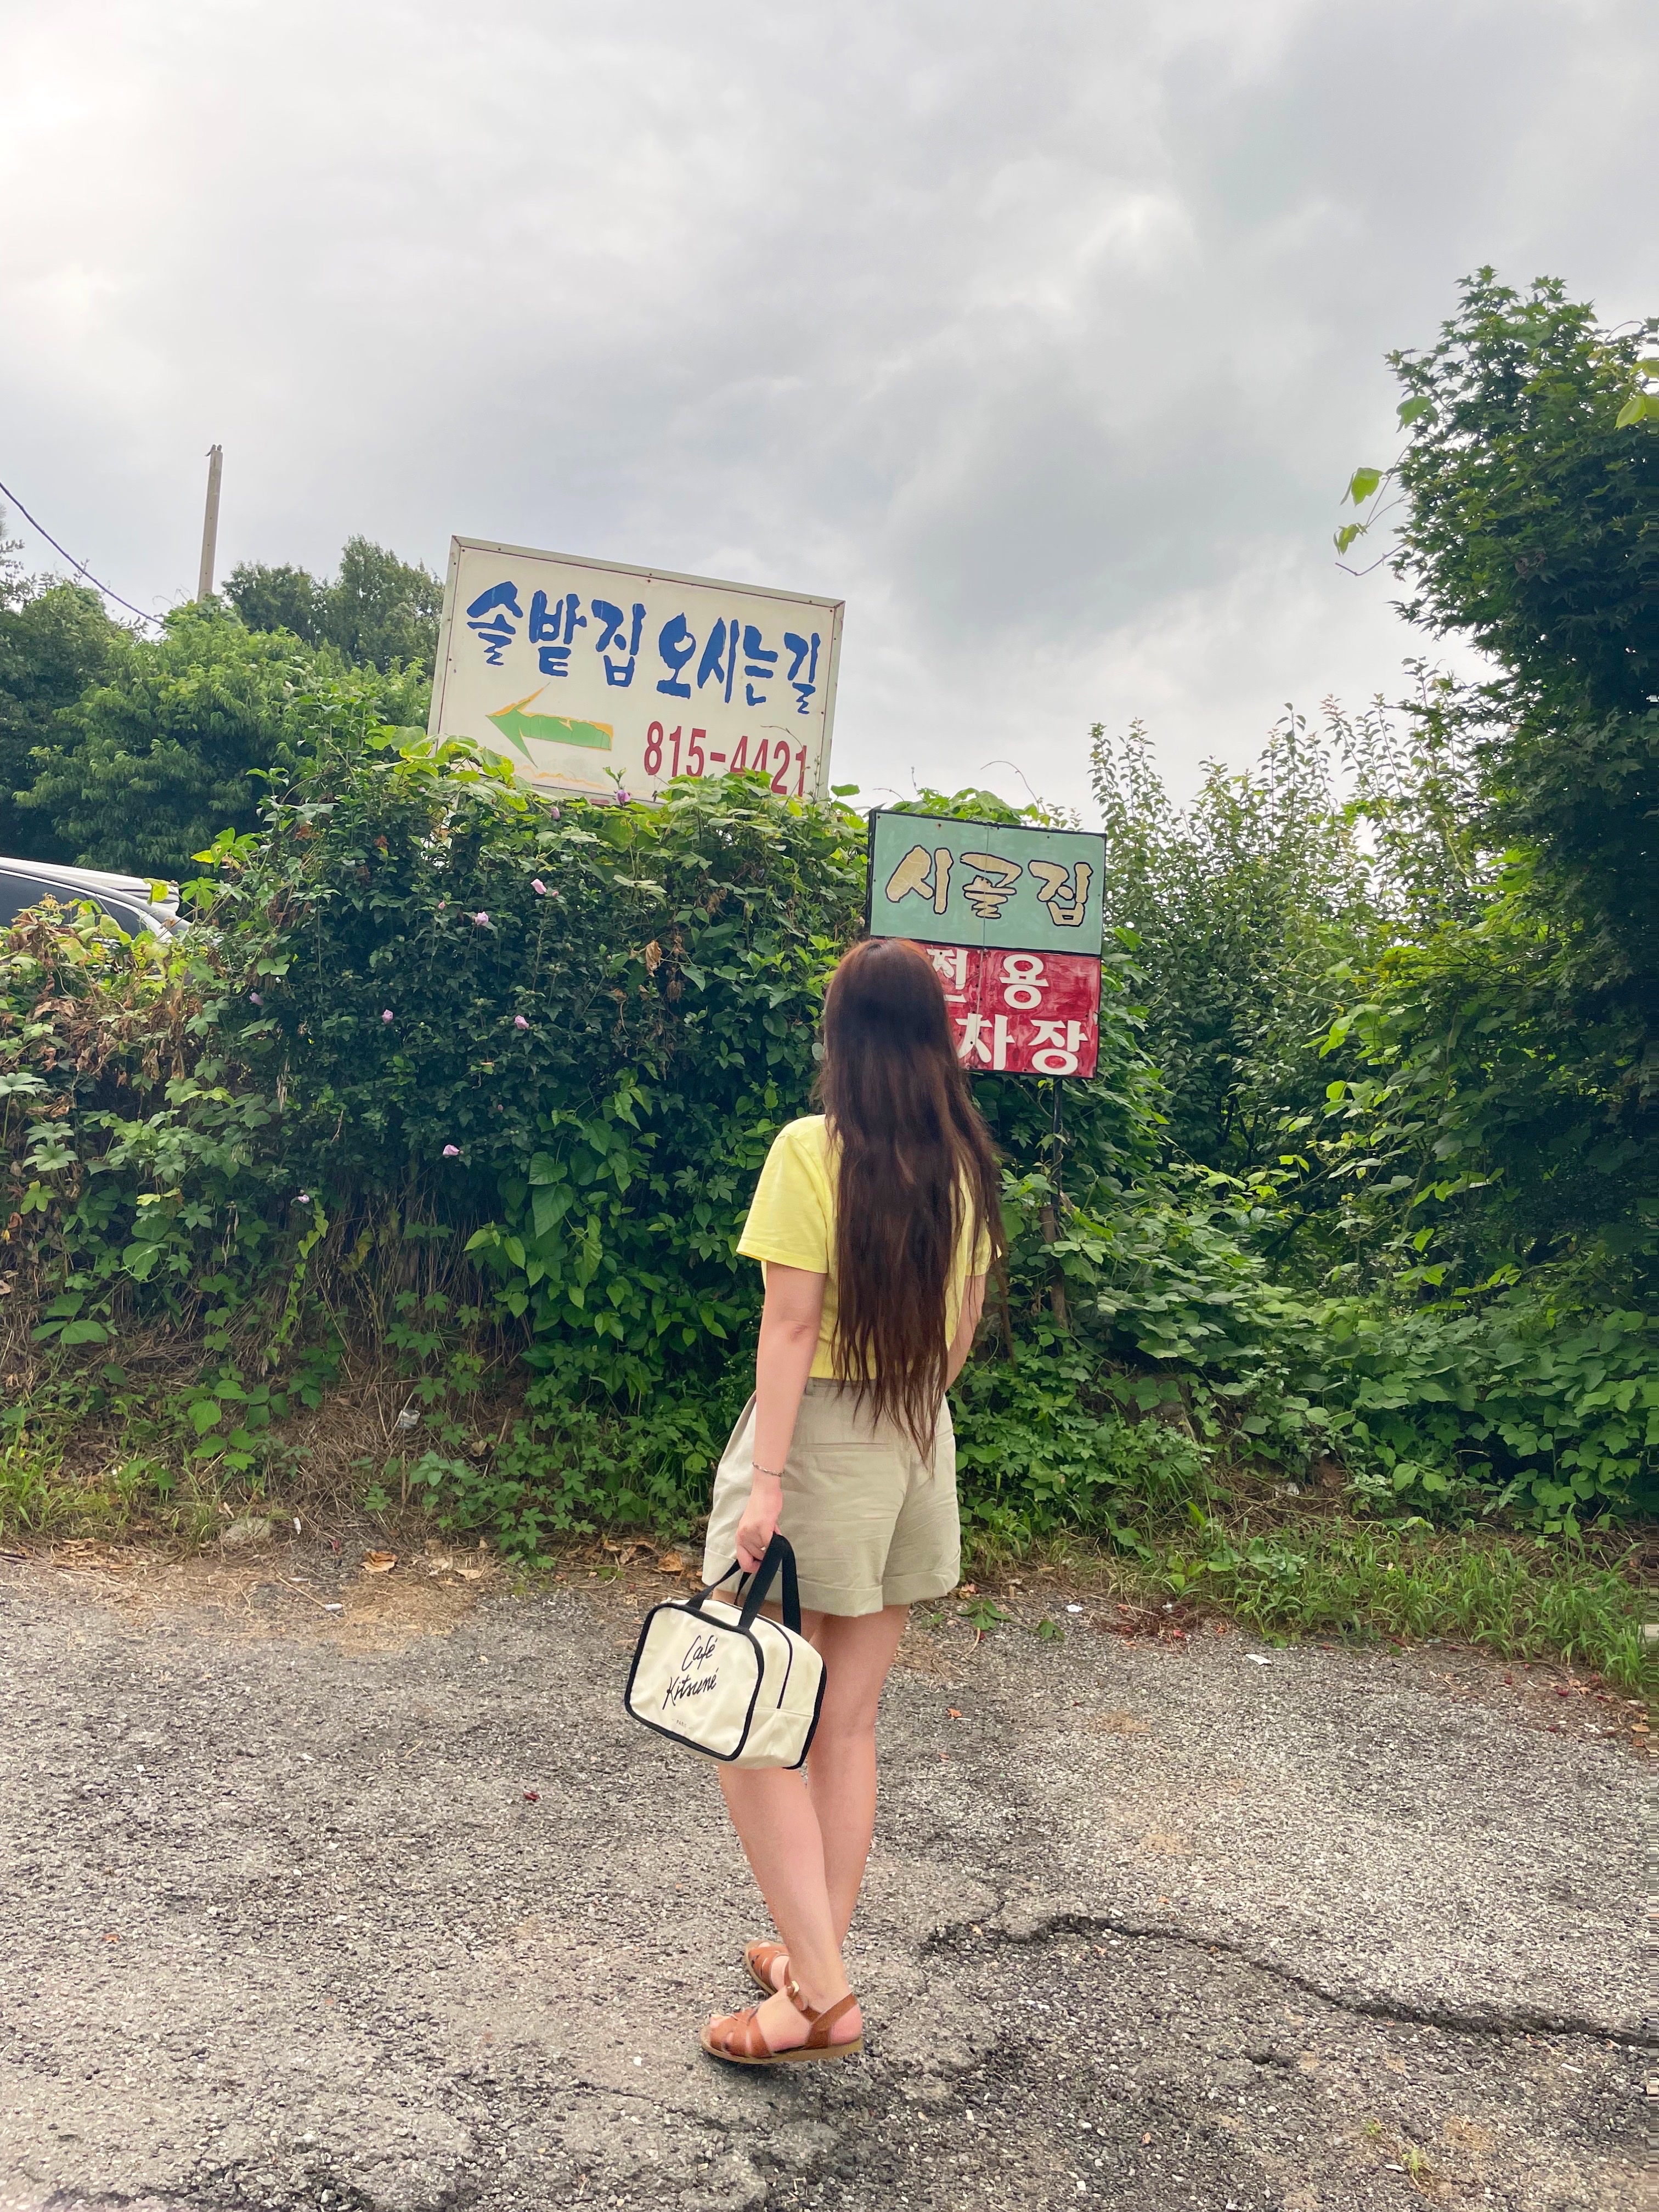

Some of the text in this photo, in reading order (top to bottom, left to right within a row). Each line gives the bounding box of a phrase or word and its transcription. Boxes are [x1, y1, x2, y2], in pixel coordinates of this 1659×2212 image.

[466, 581, 821, 714] 솔밭집 오시는길
[644, 721, 807, 797] 815-4421
[885, 845, 1094, 927] 시골집
[955, 1012, 1089, 1075] 차장
[681, 1635, 718, 1671] Café
[662, 1667, 719, 1710] Kitsuné
